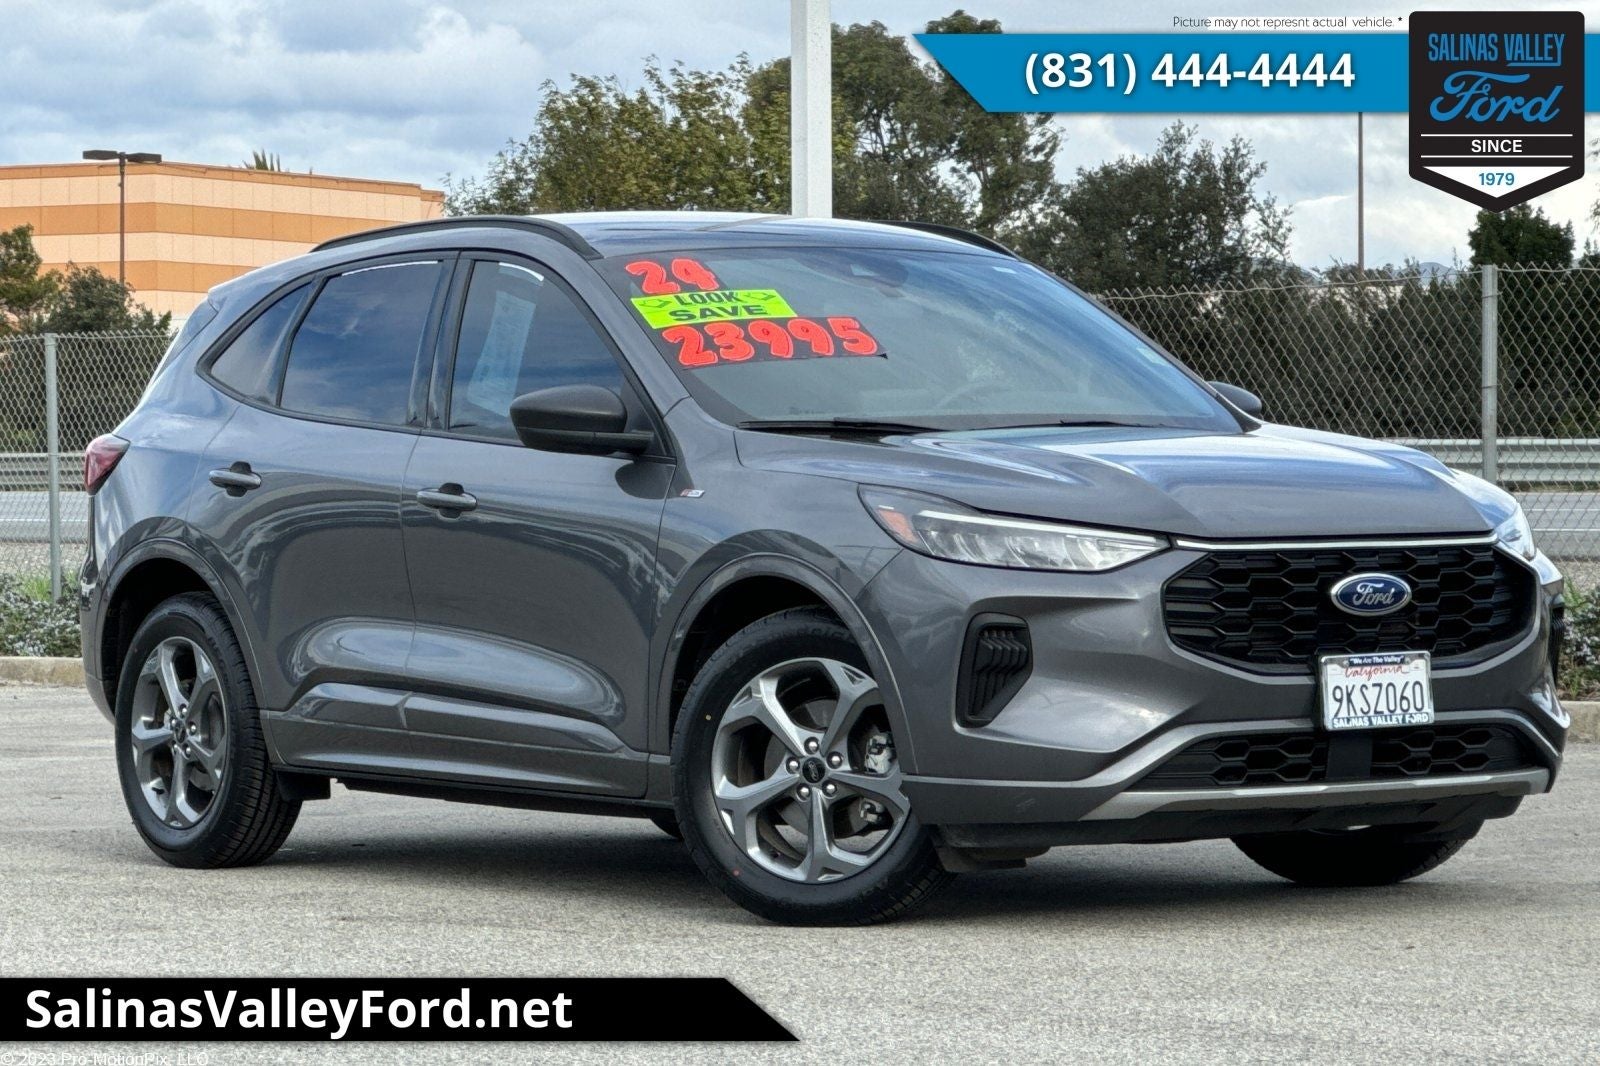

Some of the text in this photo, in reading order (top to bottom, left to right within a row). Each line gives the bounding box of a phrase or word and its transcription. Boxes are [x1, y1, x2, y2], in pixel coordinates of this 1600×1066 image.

[625, 258, 720, 294] 24
[673, 291, 743, 306] LOOK
[669, 304, 769, 322] SAVE
[662, 316, 878, 366] 23995
[1352, 582, 1395, 606] Ford
[1344, 665, 1410, 681] California
[1332, 680, 1425, 718] 9KSZ060
[1333, 713, 1429, 729] SALINAS VALLEY FORD
